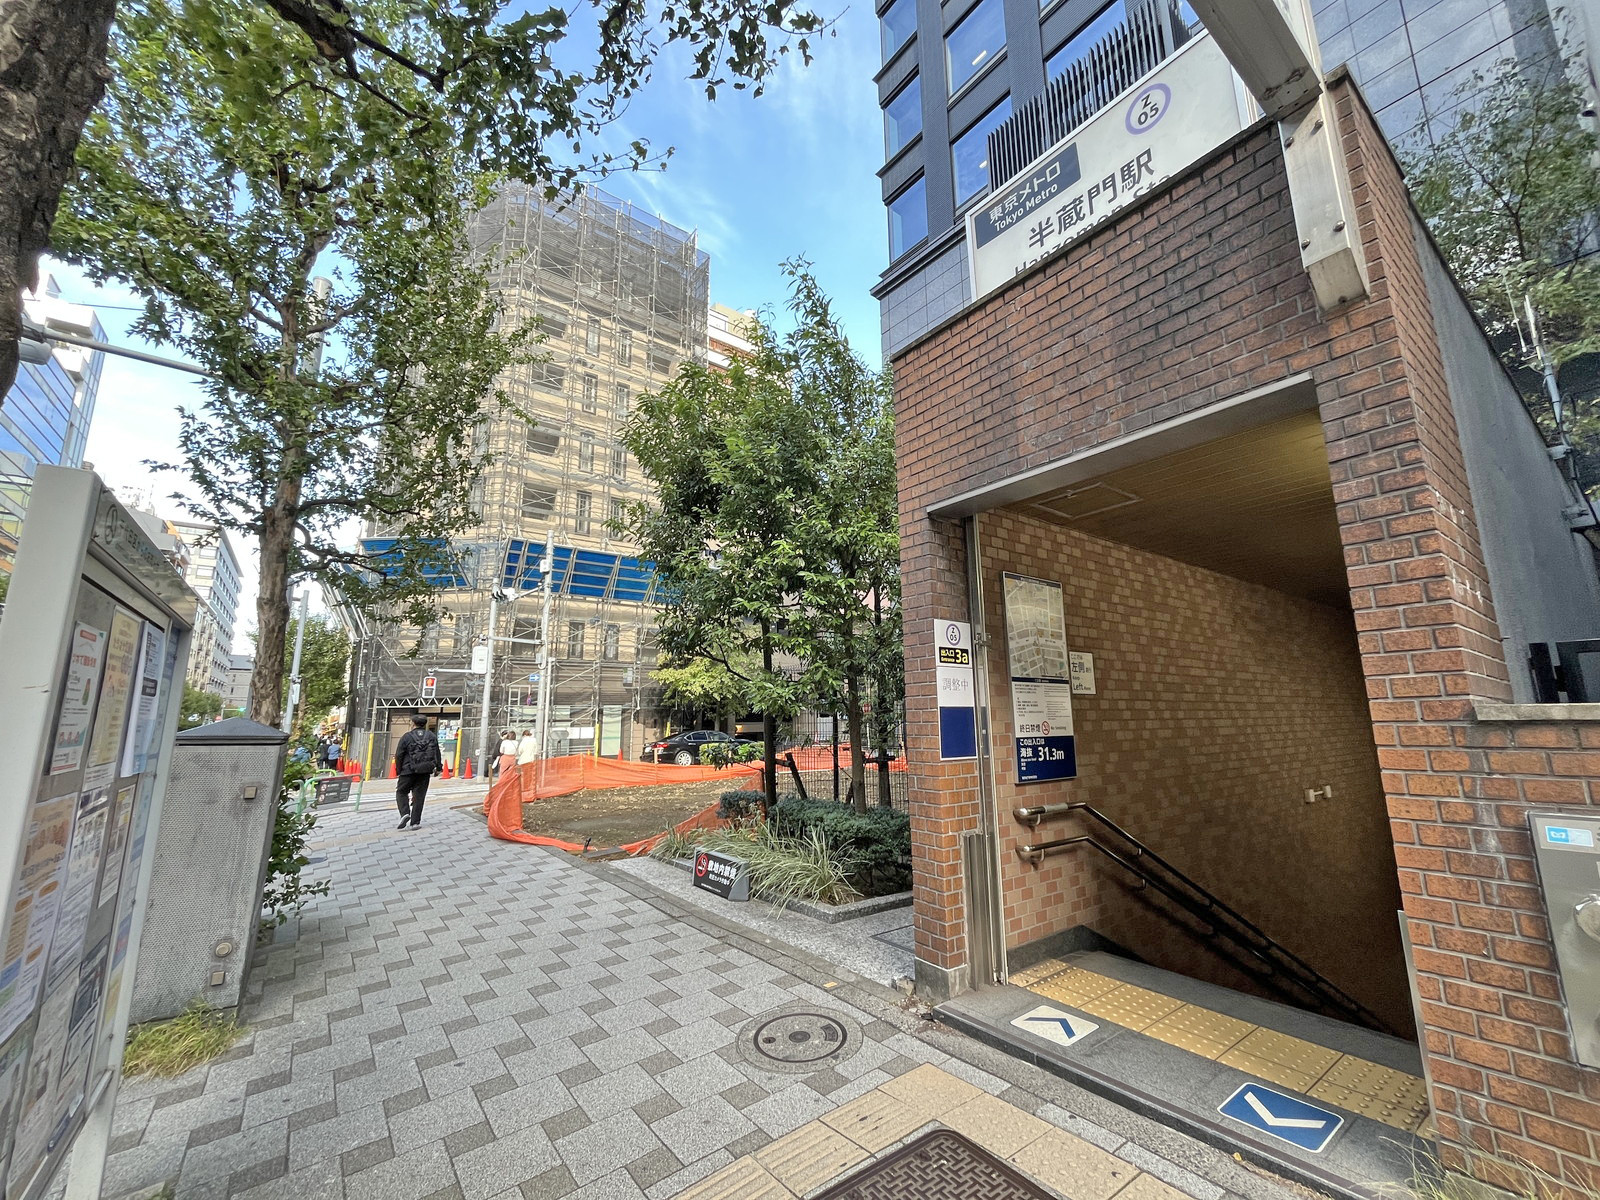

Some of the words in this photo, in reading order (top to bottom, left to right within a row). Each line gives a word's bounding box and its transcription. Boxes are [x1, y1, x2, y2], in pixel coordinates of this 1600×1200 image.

[1141, 93, 1152, 110] Z
[1137, 102, 1159, 126] 05
[989, 161, 1061, 223] 東京メトロ
[1029, 148, 1156, 248] 半蔵門駅
[994, 209, 1024, 232] Tokyo
[1026, 184, 1058, 212] Metro
[949, 634, 958, 642] 05
[955, 649, 969, 664] 3a
[942, 677, 969, 692] 調整中
[1073, 682, 1084, 690] Left
[1037, 746, 1065, 761] 31.3m
